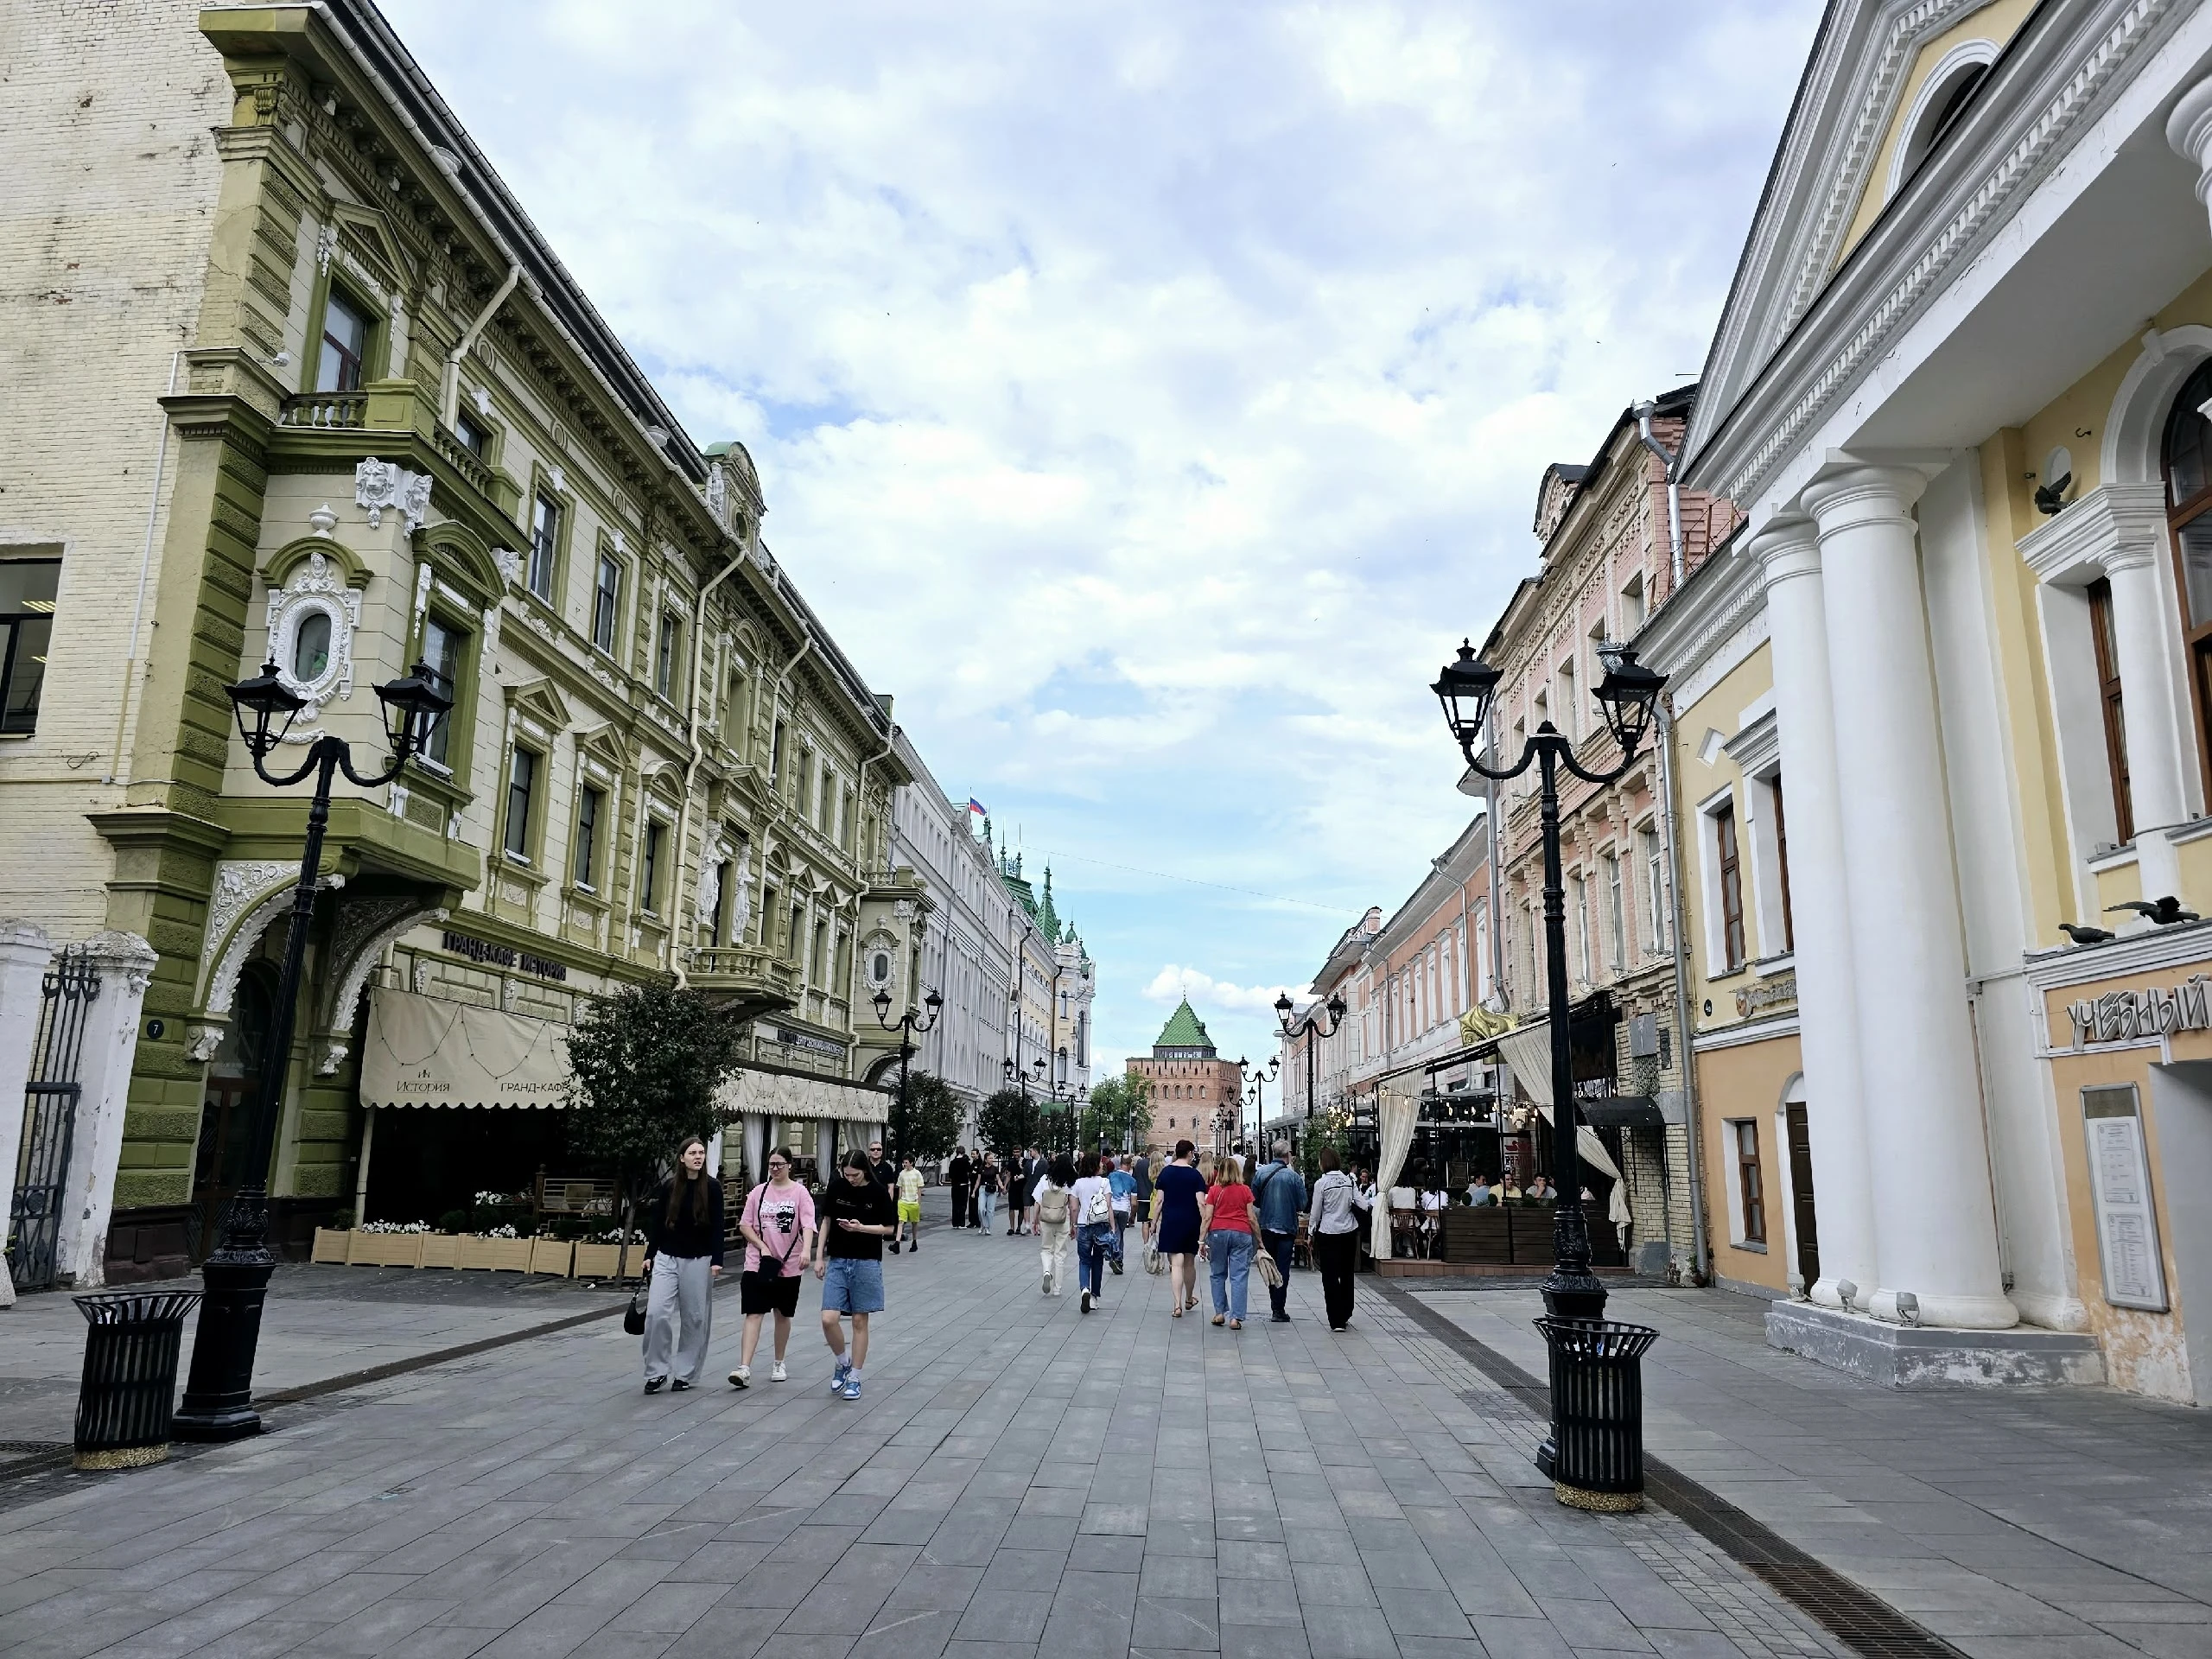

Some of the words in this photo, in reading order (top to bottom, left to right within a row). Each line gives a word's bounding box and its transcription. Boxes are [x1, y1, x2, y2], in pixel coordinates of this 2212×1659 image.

[444, 931, 518, 968] ГРАНД-КАФЕ
[521, 954, 567, 981] ИСТОРИЯ
[2067, 973, 2212, 1051] УЧЕБНЫЙ
[154, 1024, 159, 1034] 7
[397, 1081, 450, 1094] История
